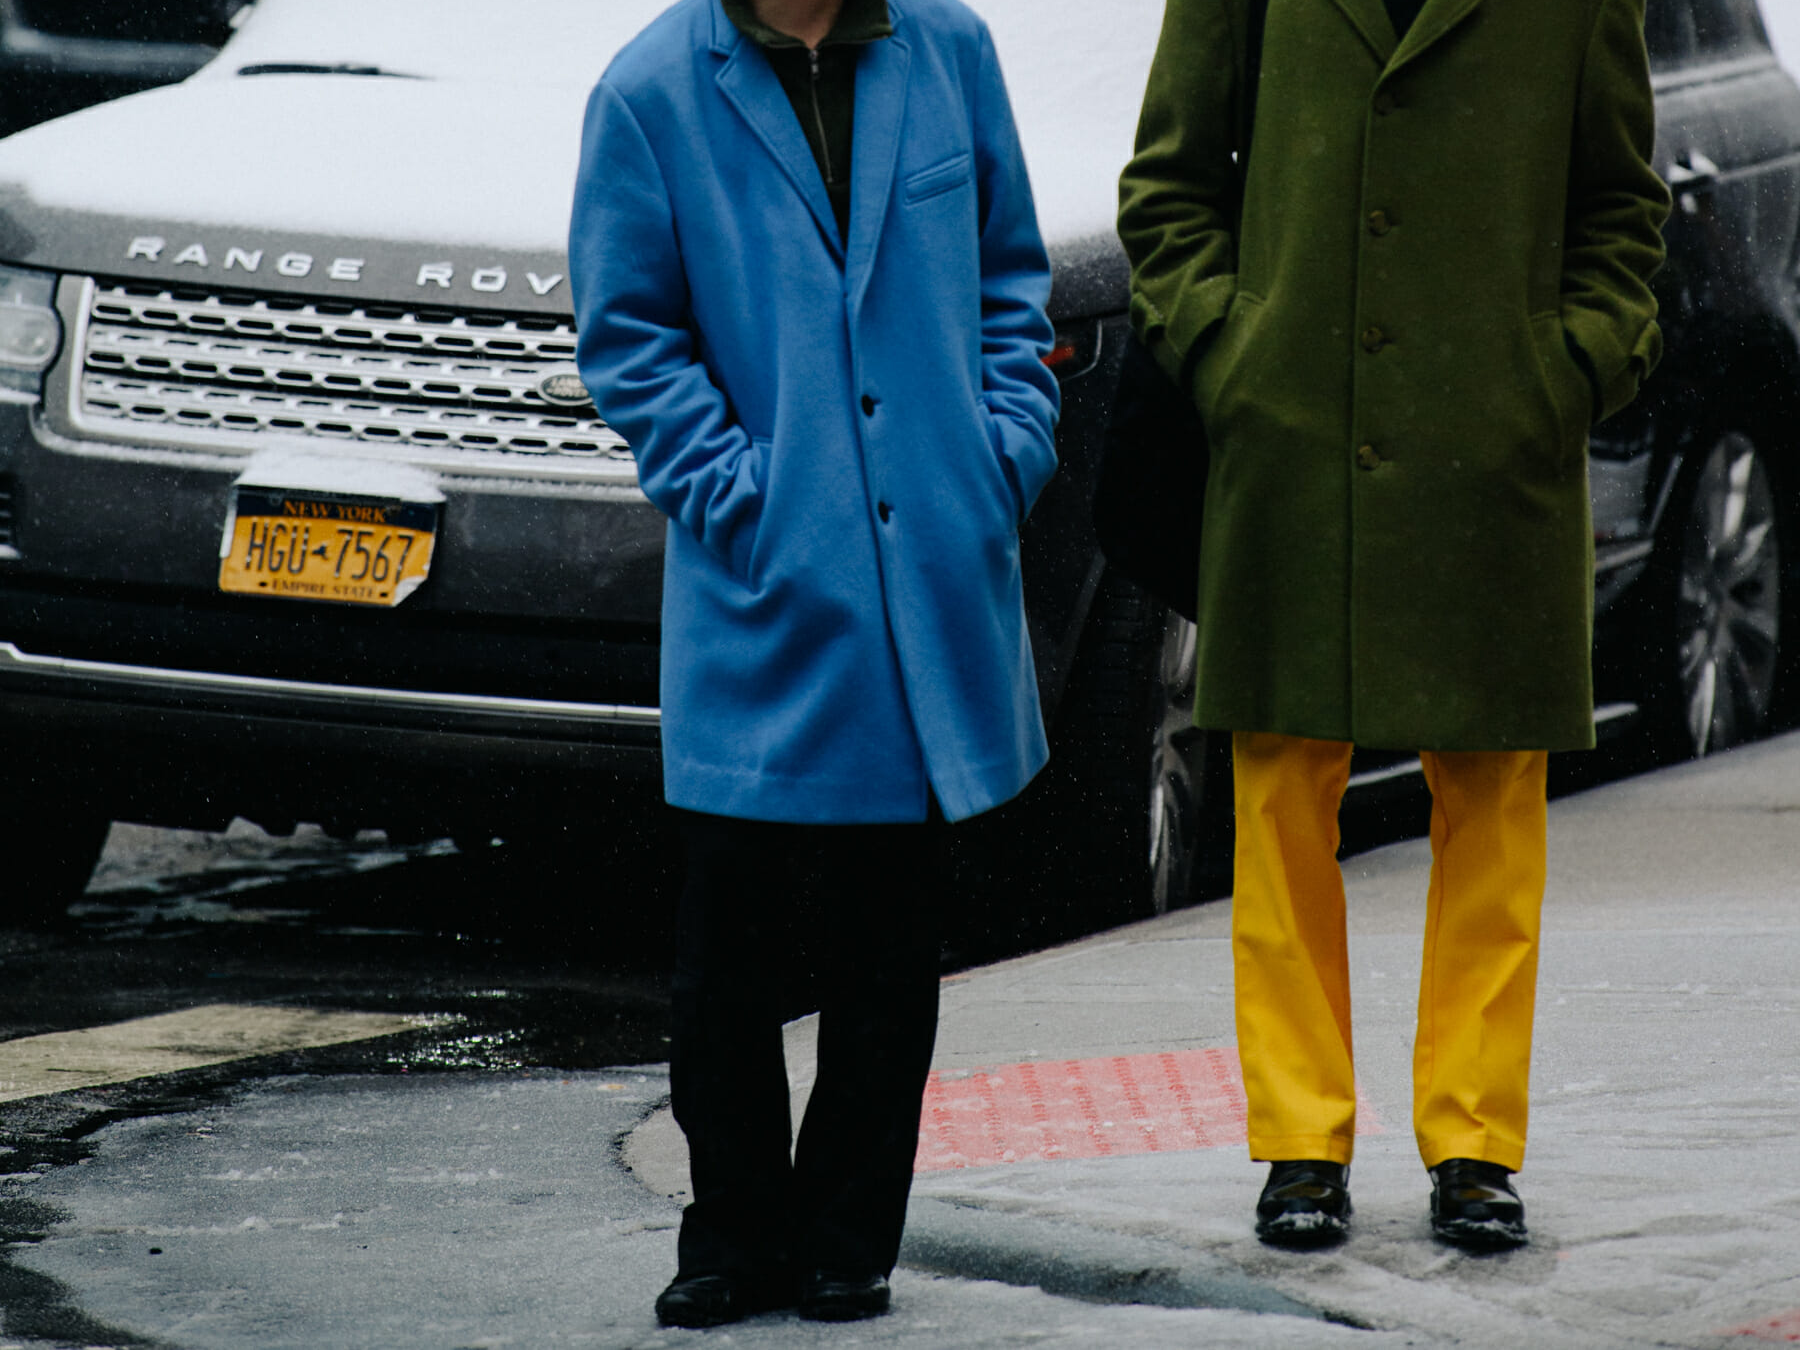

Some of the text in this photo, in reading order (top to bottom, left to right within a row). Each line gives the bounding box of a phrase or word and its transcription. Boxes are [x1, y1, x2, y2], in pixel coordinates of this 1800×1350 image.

[127, 236, 365, 281] RANGE
[284, 500, 387, 523] NEW YORK
[245, 519, 415, 583] HGU 7567
[271, 579, 376, 599] EMPIRE STATE
